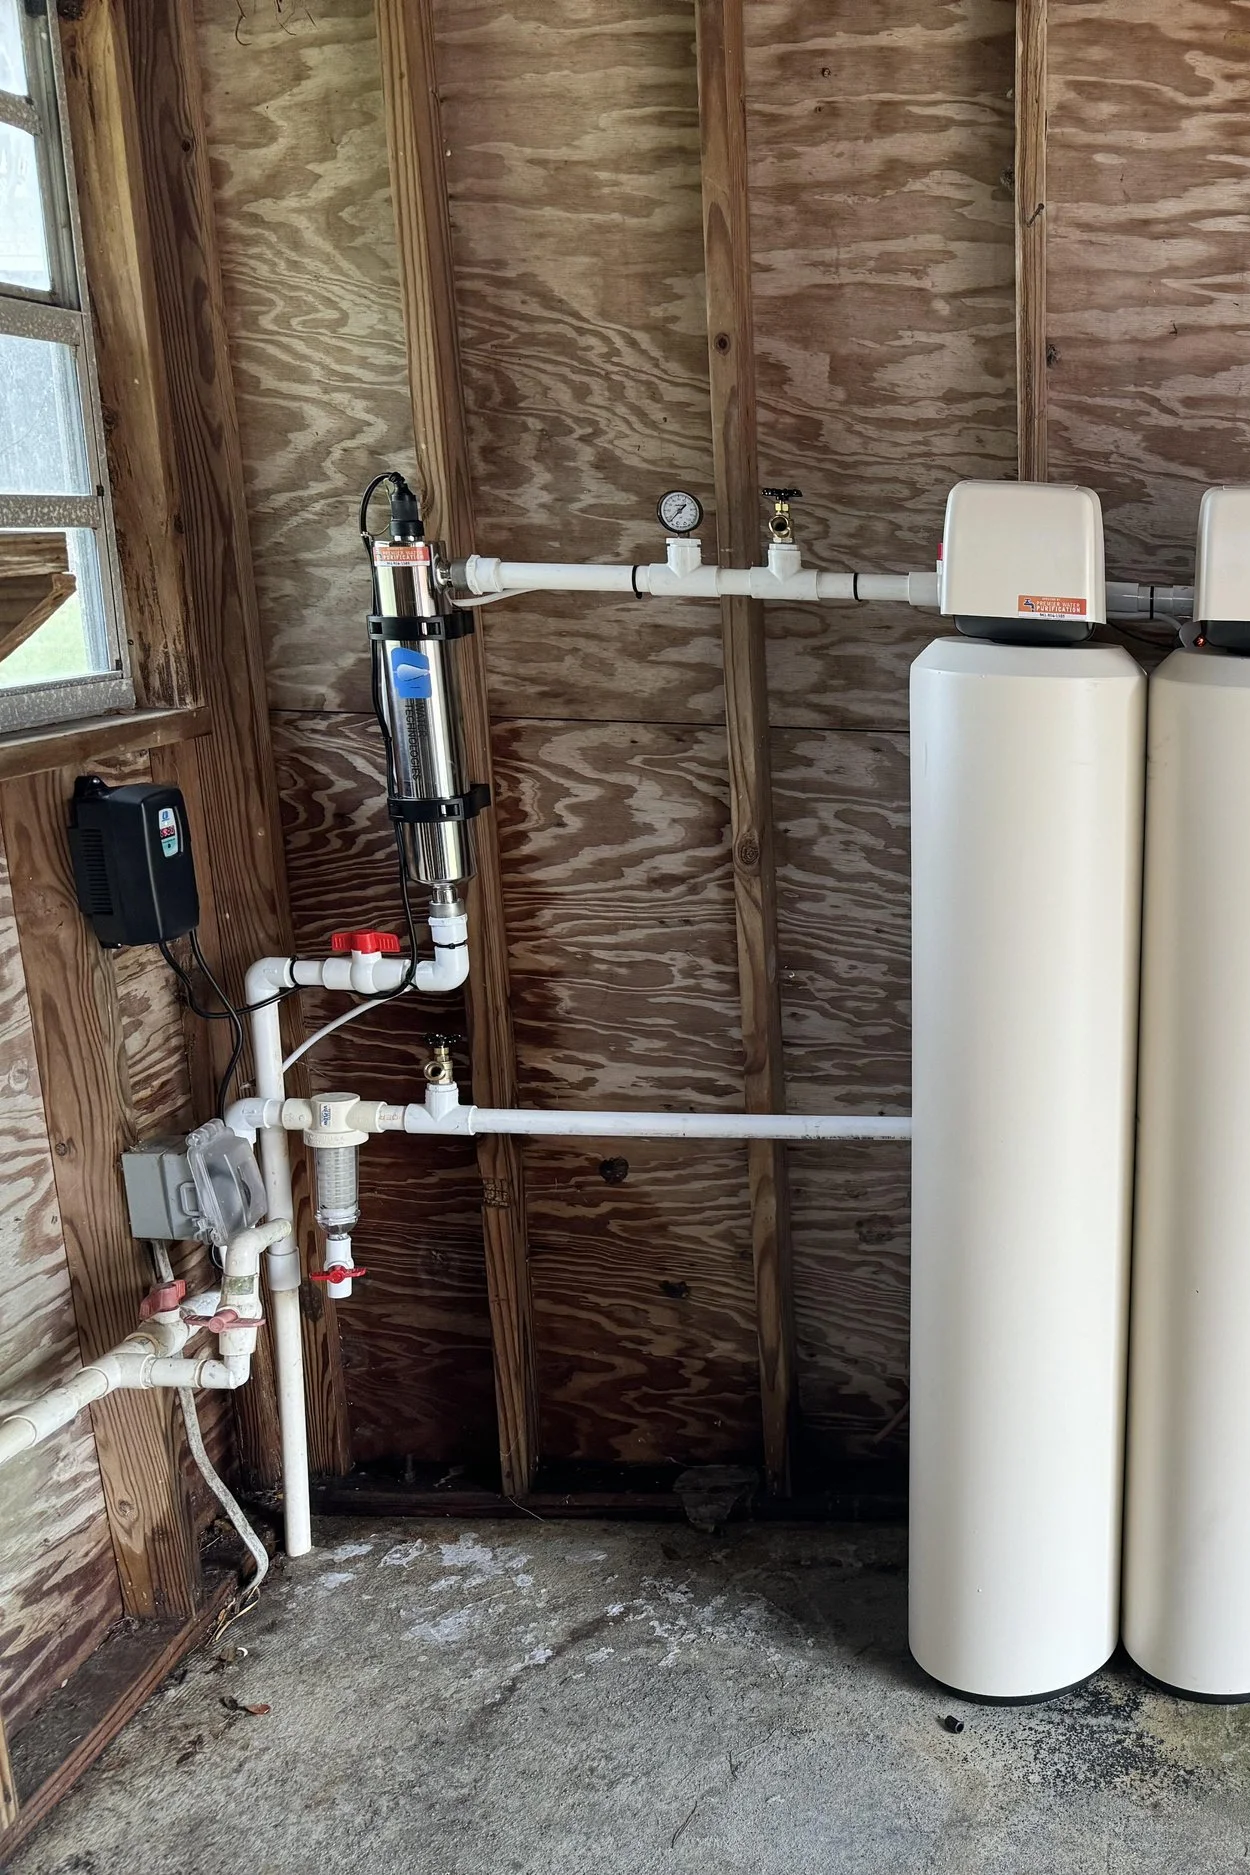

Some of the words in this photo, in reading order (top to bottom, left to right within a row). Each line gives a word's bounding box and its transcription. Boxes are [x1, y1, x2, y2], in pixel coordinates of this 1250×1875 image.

[1036, 605, 1081, 613] PURIFICATION
[416, 701, 428, 738] WATER
[404, 703, 421, 781] TECHNOLOGIES
